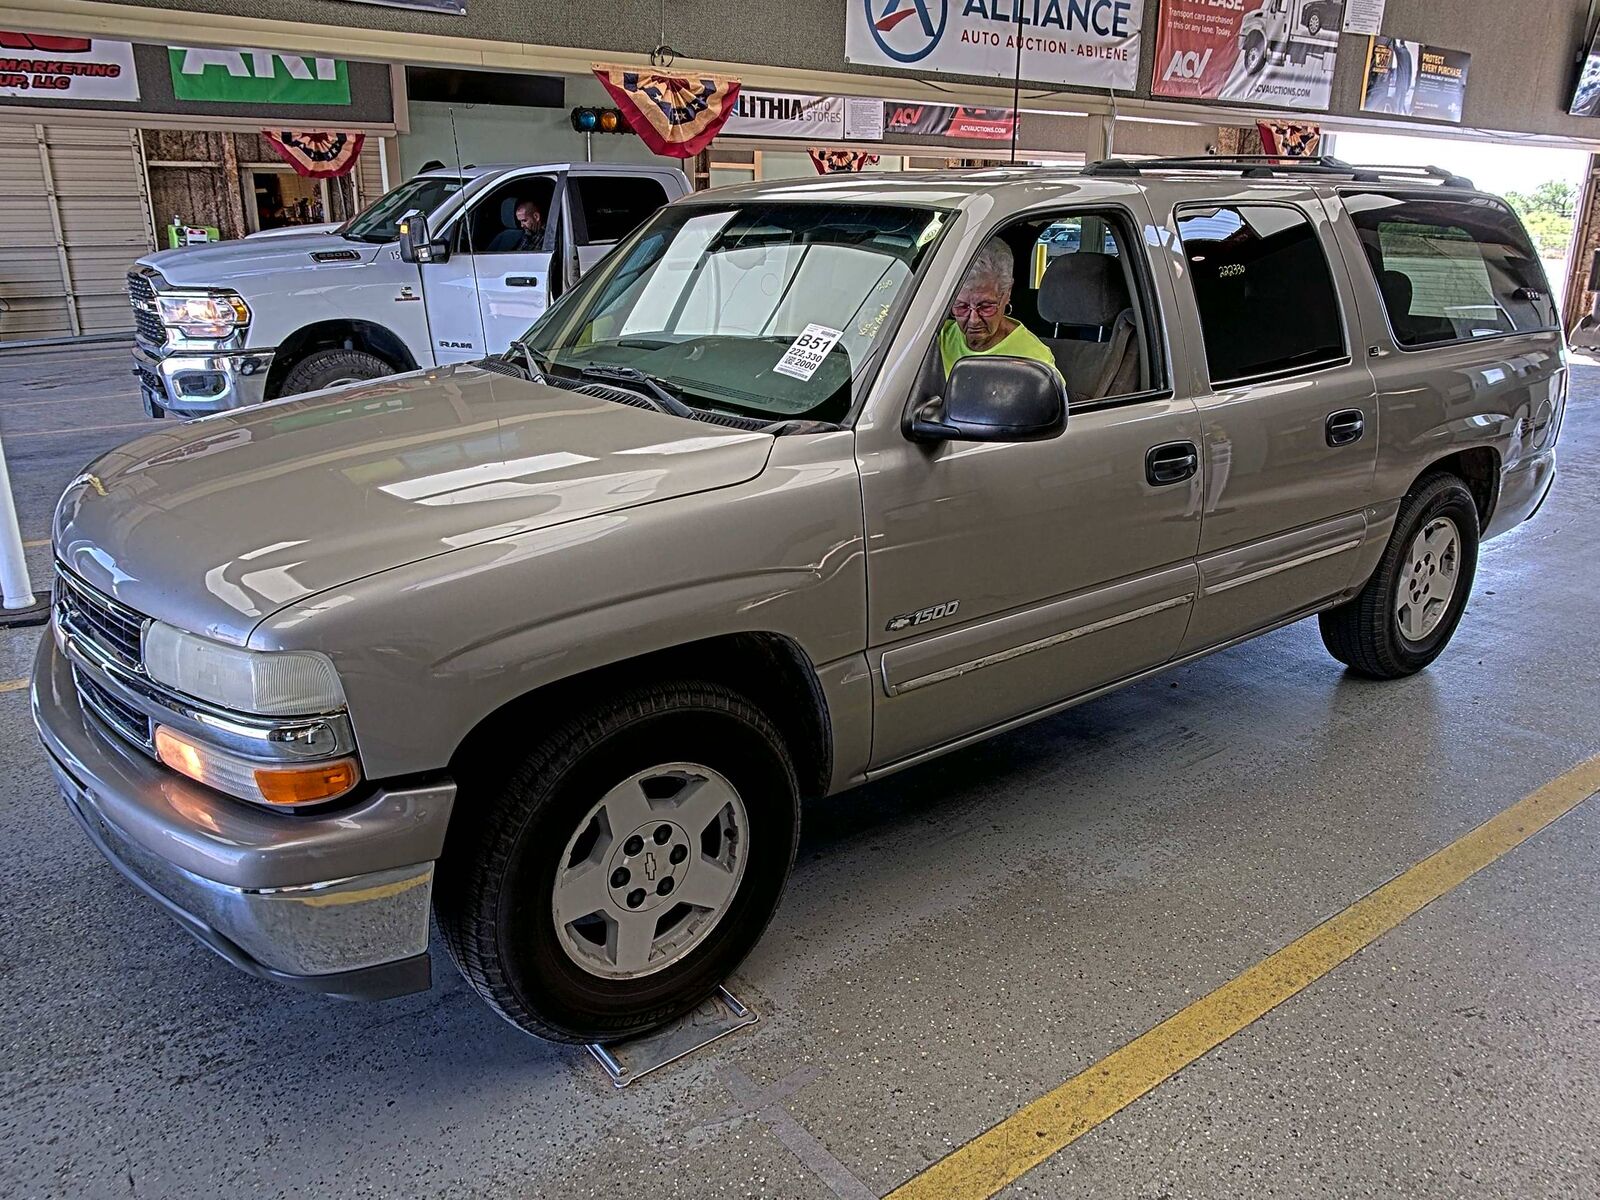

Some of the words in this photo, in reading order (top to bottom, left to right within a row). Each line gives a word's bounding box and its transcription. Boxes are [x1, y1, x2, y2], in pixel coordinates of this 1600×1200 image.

[962, 0, 1131, 38] ALLIANCE
[1169, 7, 1194, 19] Transport
[1206, 15, 1233, 25] purchased
[1173, 21, 1184, 30] this
[961, 29, 1000, 46] AUTO
[1006, 35, 1067, 54] AUCTION
[1077, 44, 1128, 61] ABILENE
[1163, 48, 1213, 80] ACV
[1422, 53, 1445, 65] PROTECT
[0, 58, 121, 77] MARKETING
[1421, 63, 1438, 75] EVERY
[31, 75, 71, 89] LLC
[1254, 84, 1311, 97] CVAUCTIONS.COM
[740, 95, 803, 121] LITHIA
[806, 102, 831, 112] AUTO
[806, 111, 842, 123] STORES
[890, 105, 923, 126] ACV
[960, 125, 1007, 134] ACVAUCTIONS.COM
[439, 340, 473, 349] RAM
[797, 334, 831, 353] B51
[789, 347, 822, 363] 222,330
[794, 358, 816, 371] 2000
[913, 599, 960, 626] 1500
